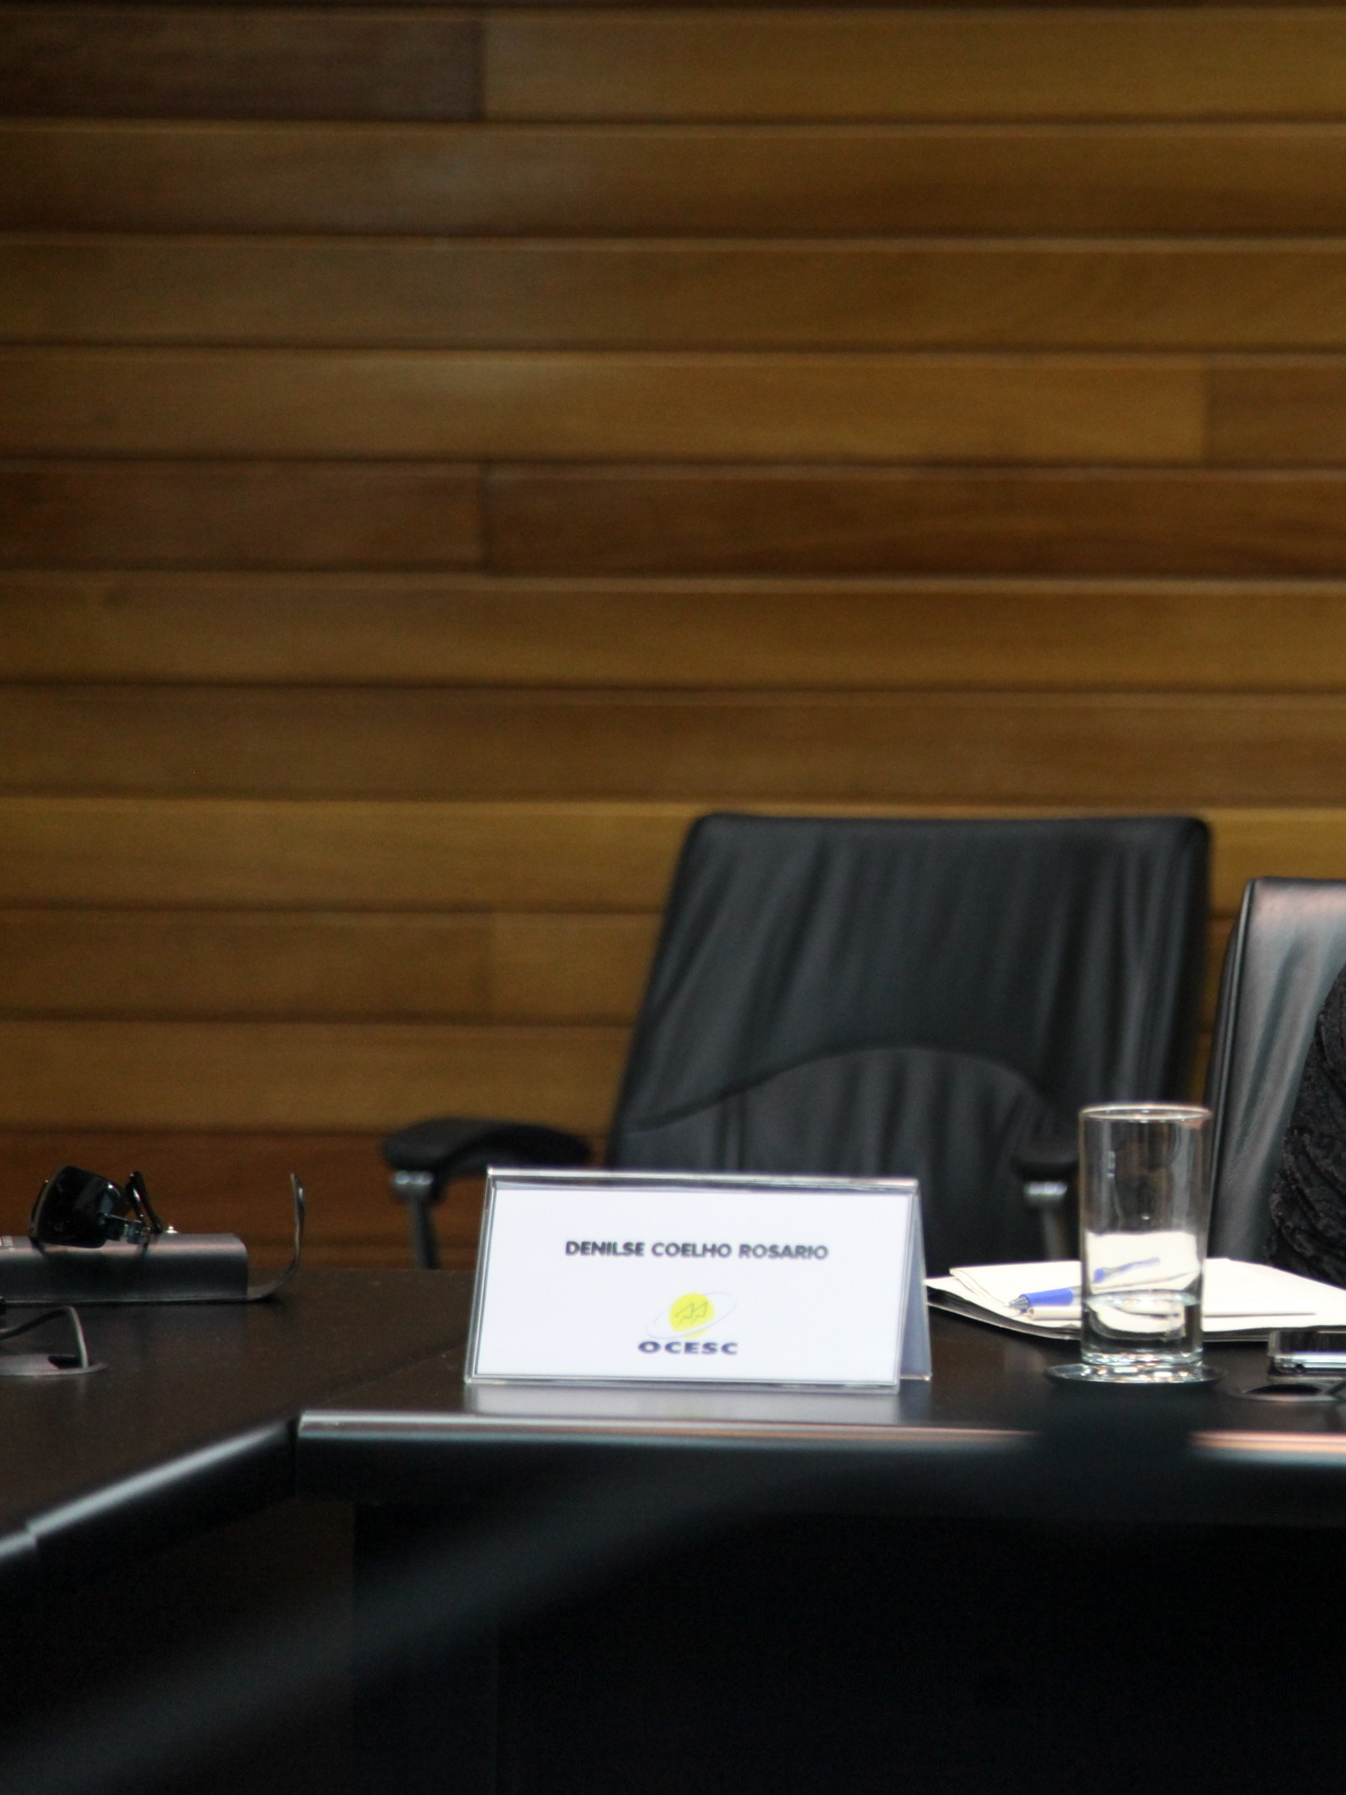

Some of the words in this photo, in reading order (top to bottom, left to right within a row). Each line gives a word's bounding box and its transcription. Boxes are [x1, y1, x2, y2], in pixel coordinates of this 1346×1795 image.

[564, 1240, 645, 1258] DENILSE
[651, 1242, 732, 1259] COELHO
[738, 1243, 829, 1260] ROSARIO
[637, 1341, 738, 1355] OCESC
